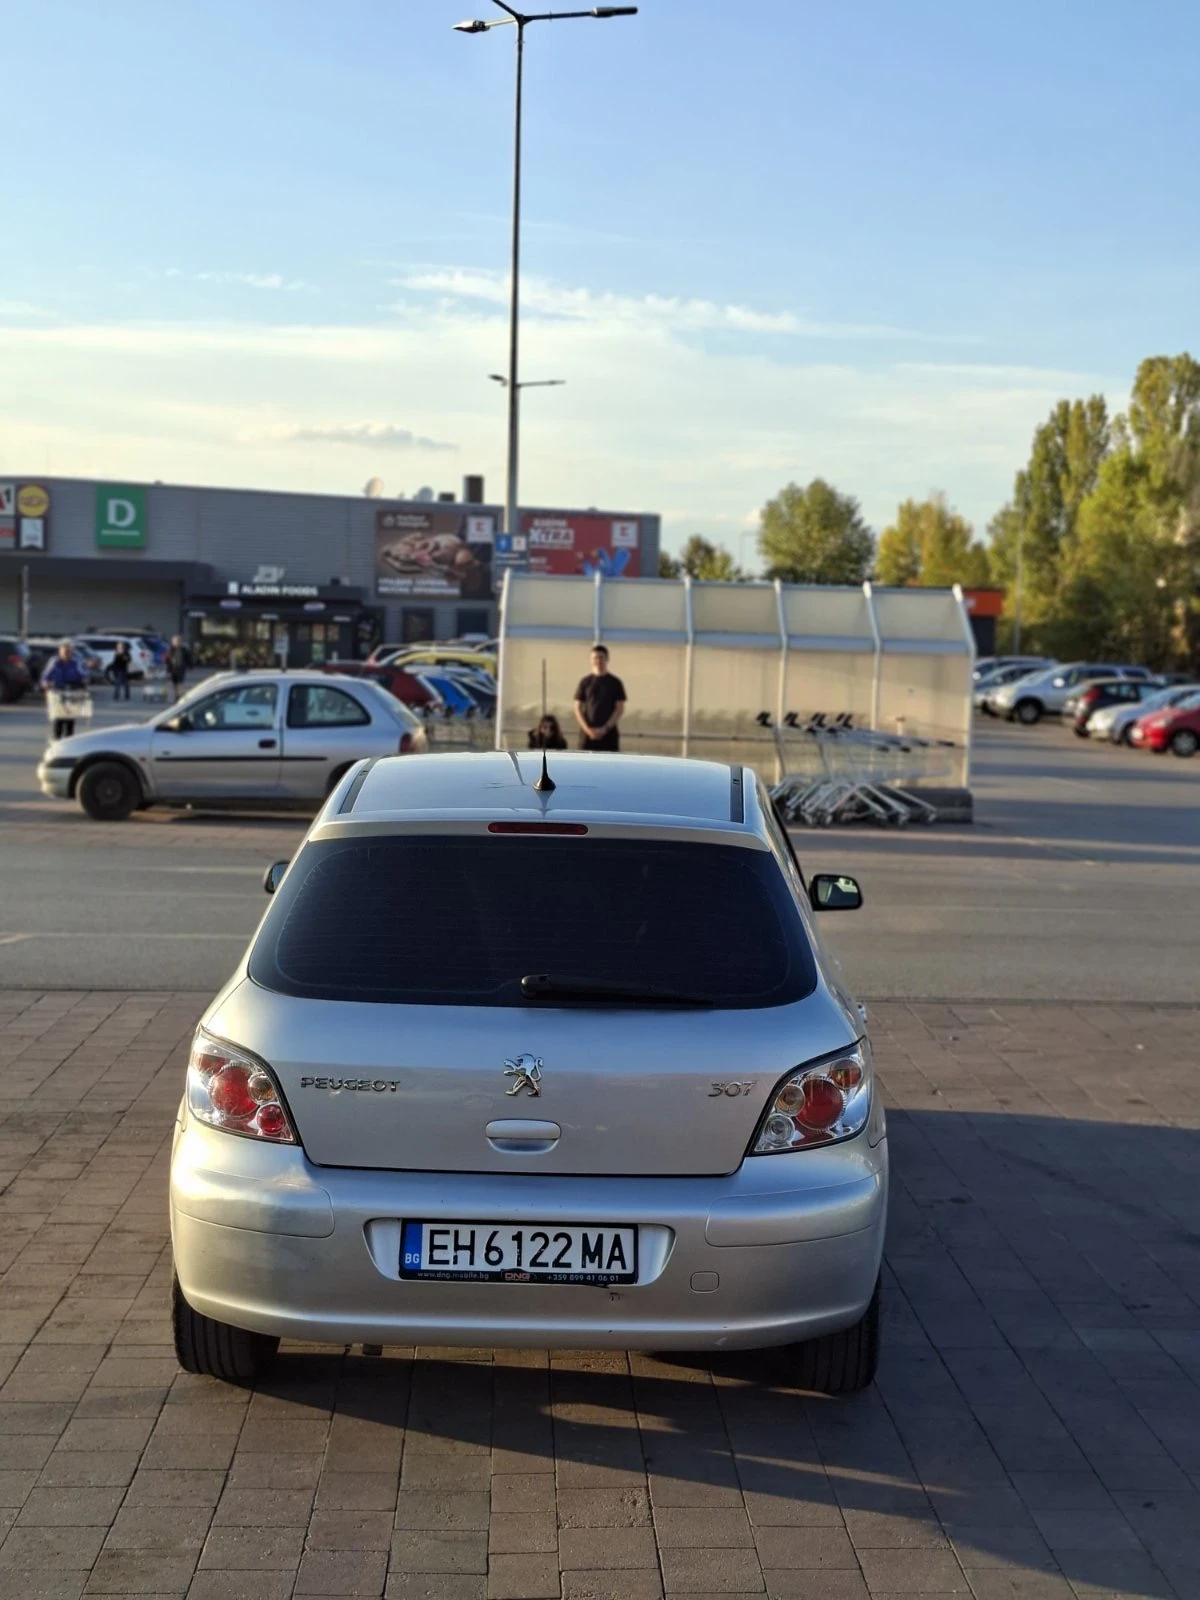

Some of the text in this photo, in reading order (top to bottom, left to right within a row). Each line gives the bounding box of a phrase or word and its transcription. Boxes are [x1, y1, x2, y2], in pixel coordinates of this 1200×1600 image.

[107, 498, 136, 527] D
[300, 1076, 401, 1092] PEUGEOT
[708, 1081, 758, 1098] 307
[404, 1252, 420, 1264] BG
